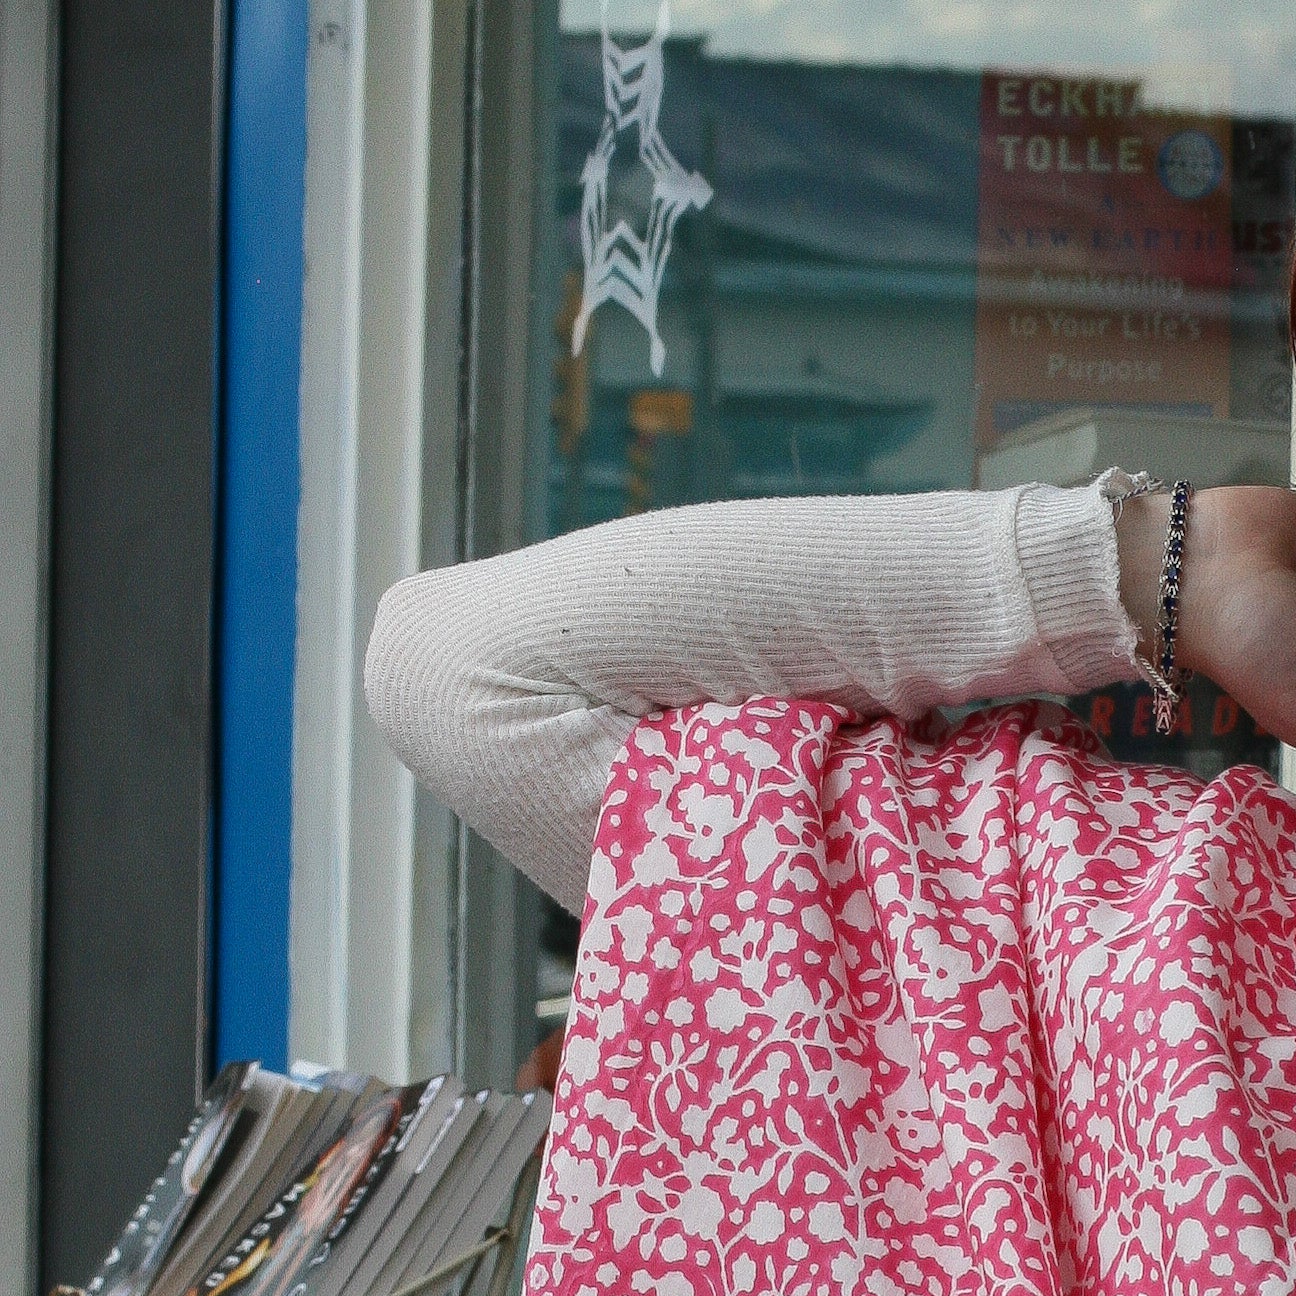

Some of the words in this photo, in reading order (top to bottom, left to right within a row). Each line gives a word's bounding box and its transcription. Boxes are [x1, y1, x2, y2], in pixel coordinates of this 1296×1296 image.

[996, 135, 1143, 173] TOLLE
[997, 227, 1070, 248] NEW
[1092, 228, 1216, 250] EARTH
[1010, 314, 1036, 337] to
[1046, 312, 1110, 338] Your
[1122, 311, 1202, 341] Life's
[1048, 353, 1162, 384] Purpose
[203, 1180, 308, 1290] MASKED
